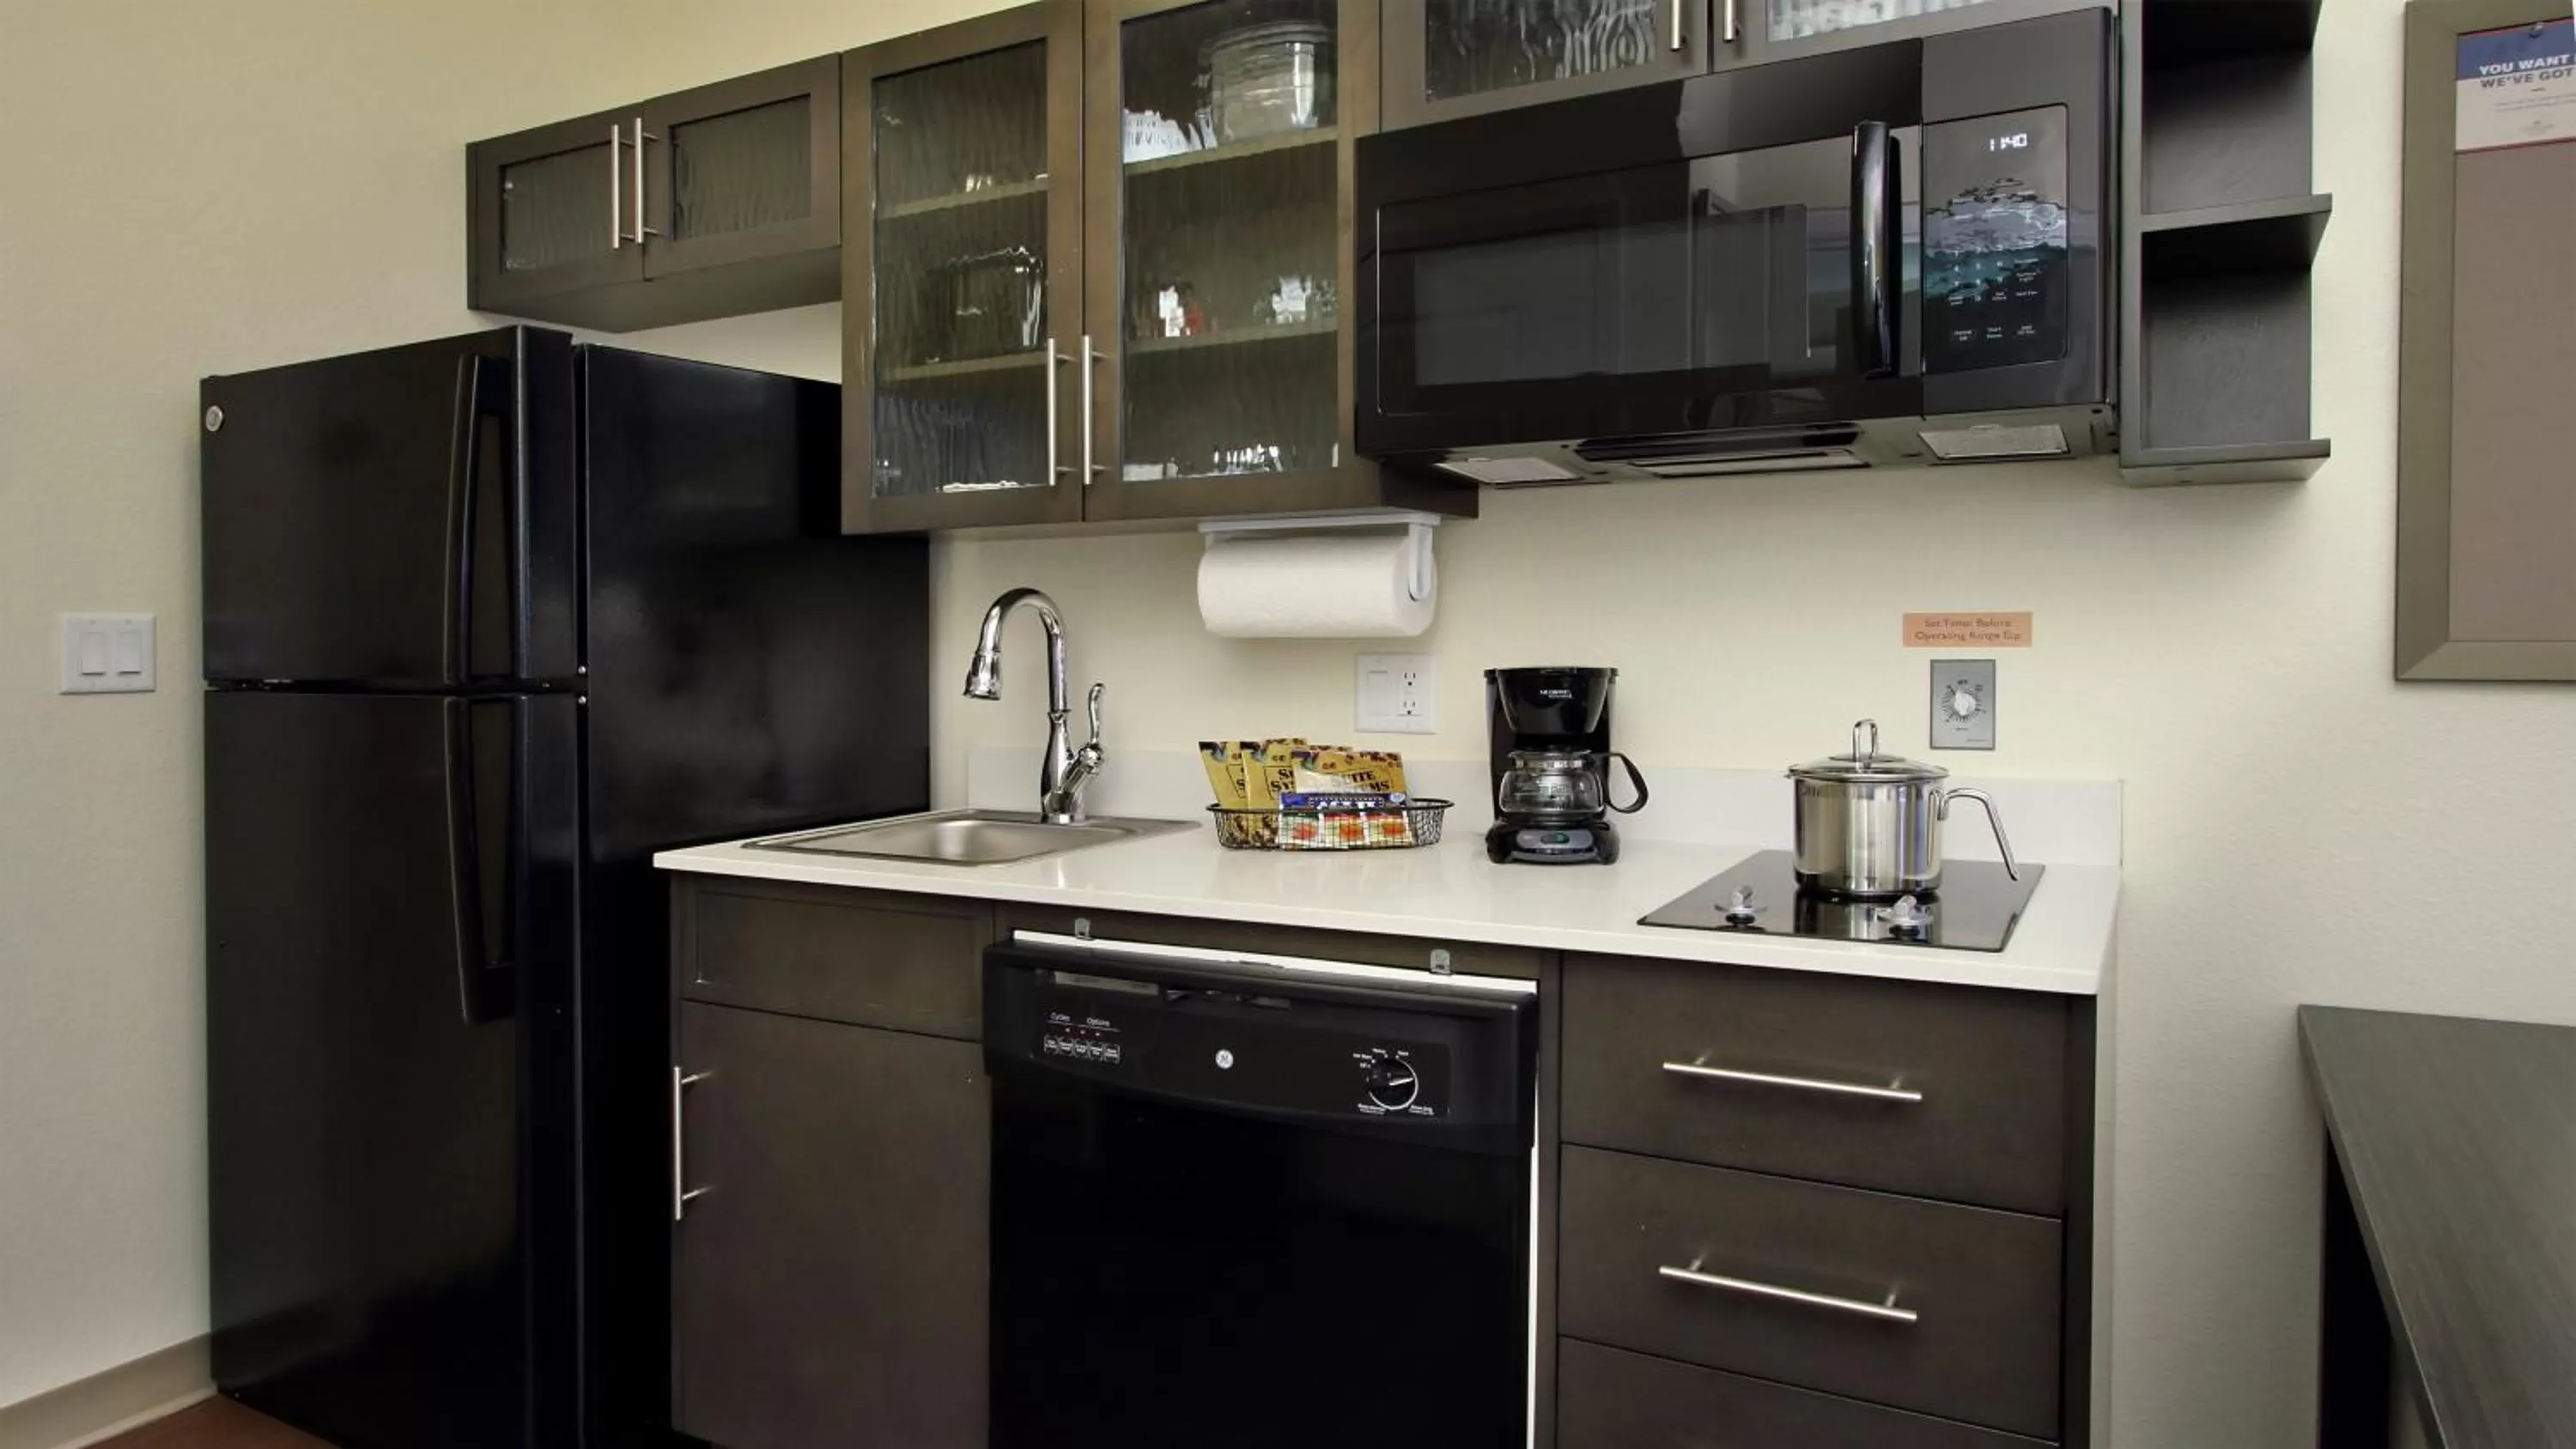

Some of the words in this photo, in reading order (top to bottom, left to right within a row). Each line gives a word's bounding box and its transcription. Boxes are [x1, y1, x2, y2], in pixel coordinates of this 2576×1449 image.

[2479, 62, 2513, 76] YOU
[2518, 54, 2570, 70] WANT
[2480, 73, 2534, 88] WE'VE
[2539, 68, 2573, 81] GOT
